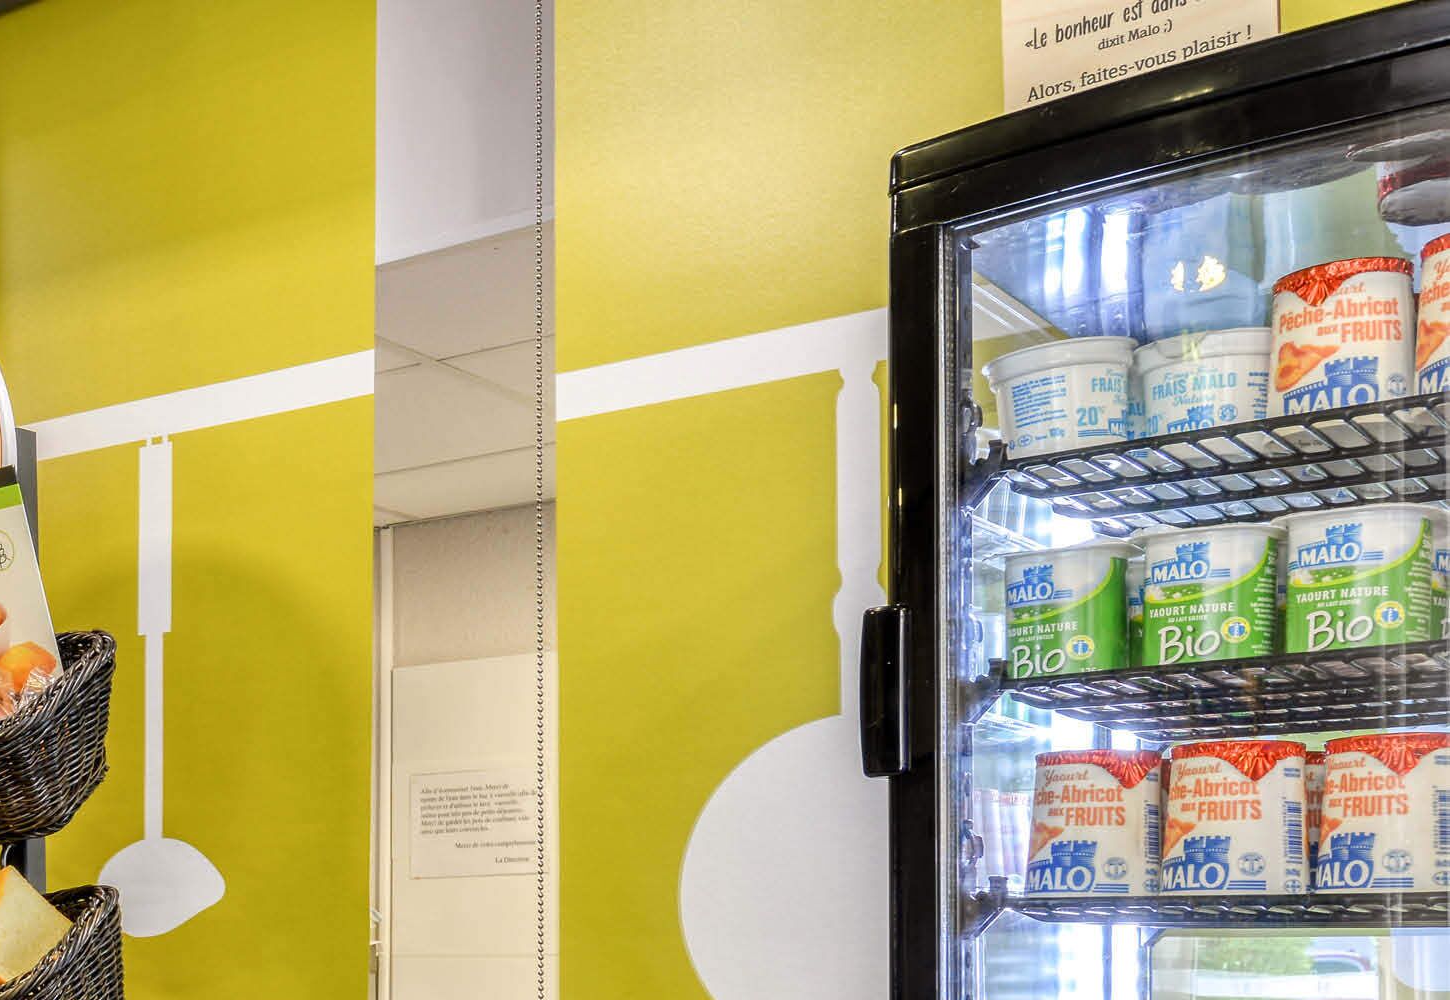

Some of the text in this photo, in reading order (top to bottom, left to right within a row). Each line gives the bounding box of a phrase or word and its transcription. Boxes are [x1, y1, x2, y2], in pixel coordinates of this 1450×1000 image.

[1056, 11, 1114, 44] bonheur
[1123, 0, 1143, 22] est
[1097, 34, 1125, 50] dixit
[1127, 24, 1160, 42] Malo
[1027, 80, 1076, 102] Alors,
[1080, 49, 1177, 87] faites-vous
[1182, 31, 1241, 60] plaisir
[1279, 296, 1399, 334] Pêche-Abricot
[1340, 319, 1403, 343] FRUITS
[1152, 378, 1187, 400] FRAIS
[1192, 372, 1238, 391] MALO
[1421, 365, 1450, 395] MA
[1288, 383, 1376, 415] MALO
[1300, 542, 1361, 567] MALO
[1153, 560, 1208, 583] MALO
[1007, 582, 1052, 603] MALO
[1295, 586, 1390, 604] YAOURT NATURE
[1150, 602, 1236, 619] YAOURT NATURE
[1038, 620, 1079, 633] NATURE
[1306, 609, 1374, 652] Bio
[1158, 625, 1221, 665] Bio
[1012, 644, 1066, 679] Bio
[1065, 805, 1127, 827] FRUITS
[1197, 800, 1263, 822] FRUITS
[1343, 794, 1409, 818] FRUITS
[1028, 865, 1092, 891] MALO
[1162, 862, 1226, 891] MALO
